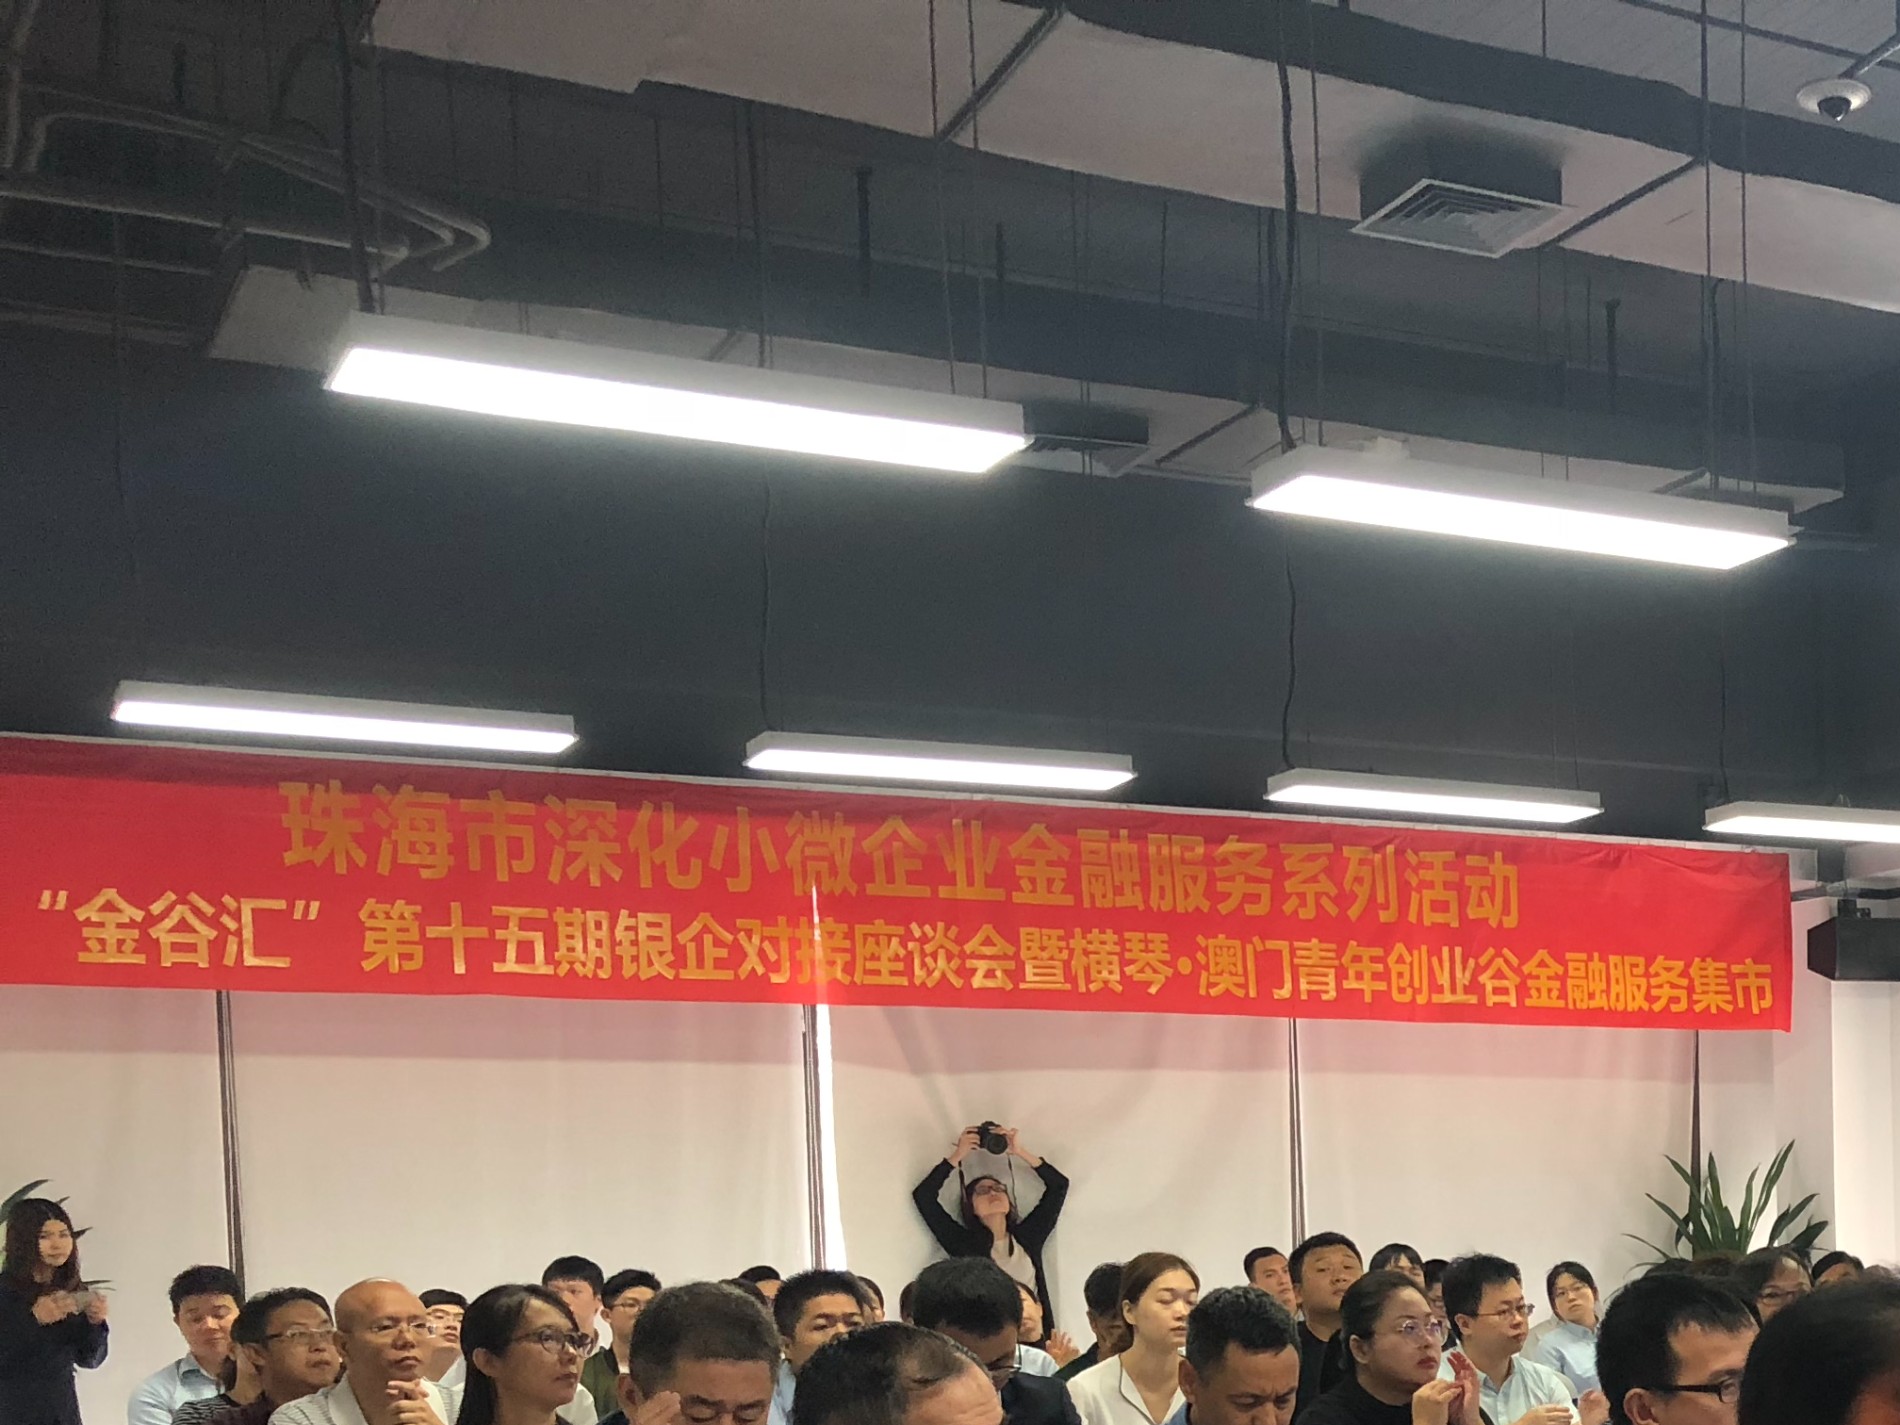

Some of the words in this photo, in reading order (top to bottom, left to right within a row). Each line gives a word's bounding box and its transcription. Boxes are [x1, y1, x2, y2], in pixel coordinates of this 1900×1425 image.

[279, 779, 1519, 929] 珠海市深化小微企业金融服务系列活动
